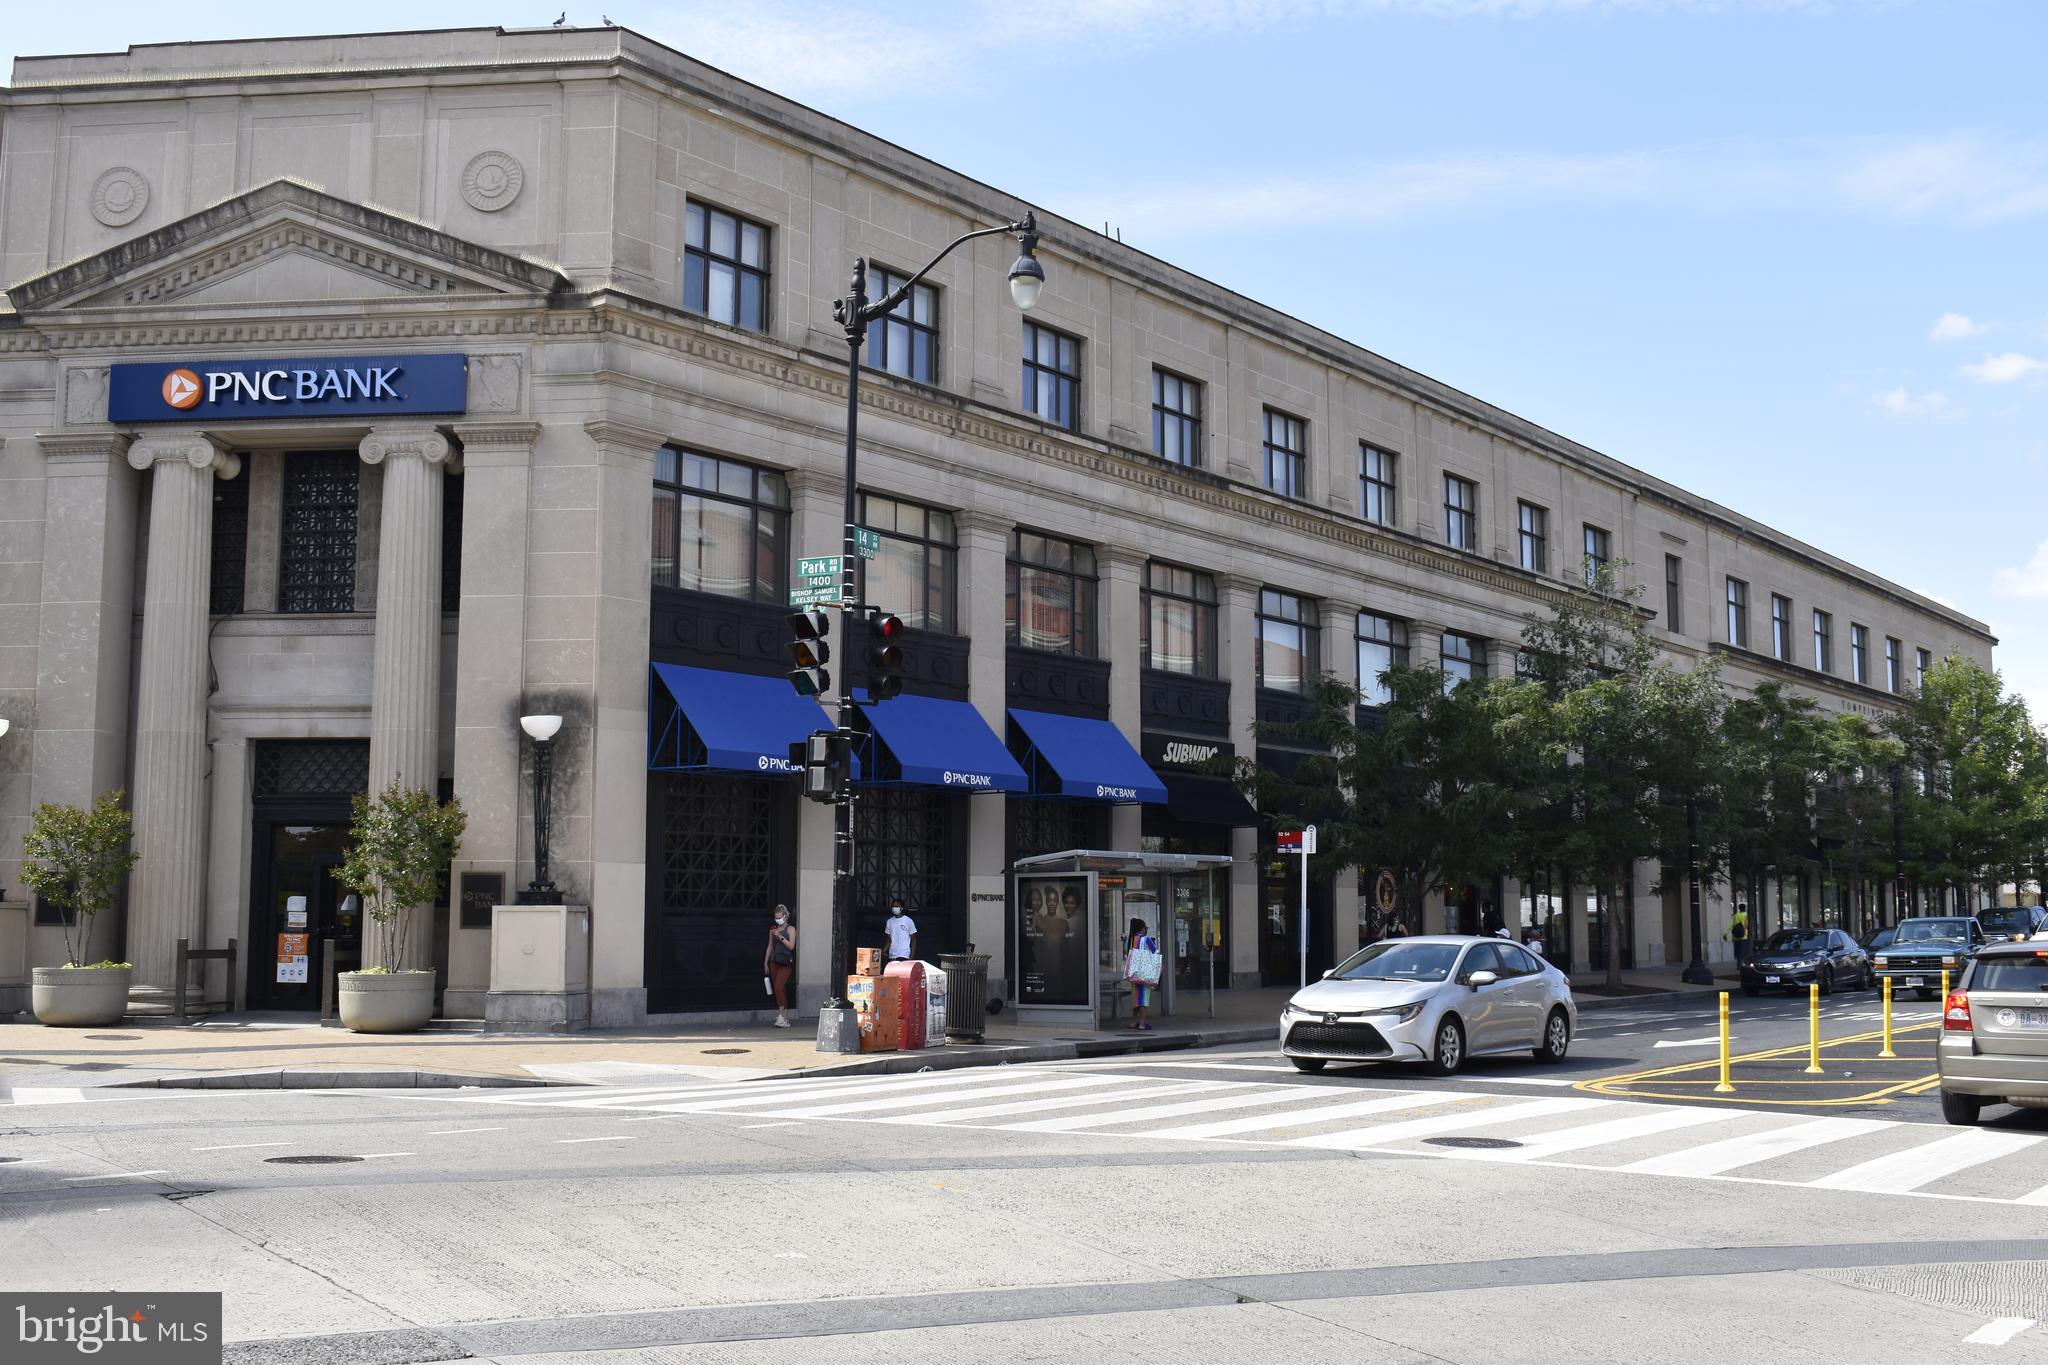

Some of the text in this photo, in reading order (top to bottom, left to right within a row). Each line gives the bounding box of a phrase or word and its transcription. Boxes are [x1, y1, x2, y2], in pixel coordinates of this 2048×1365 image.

[205, 367, 399, 402] PNC BANK
[859, 530, 867, 545] 14
[859, 546, 874, 559] 3300
[801, 560, 826, 574] Park
[809, 576, 831, 587] 1400
[791, 587, 837, 597] BISHOP SAMUEL
[1162, 741, 1219, 764] SUBWAY
[769, 758, 790, 771] PNC
[952, 772, 992, 786] PNC BANK
[1104, 786, 1137, 799] PNC BANK
[475, 891, 496, 901] PNC
[1176, 888, 1190, 897] 3306
